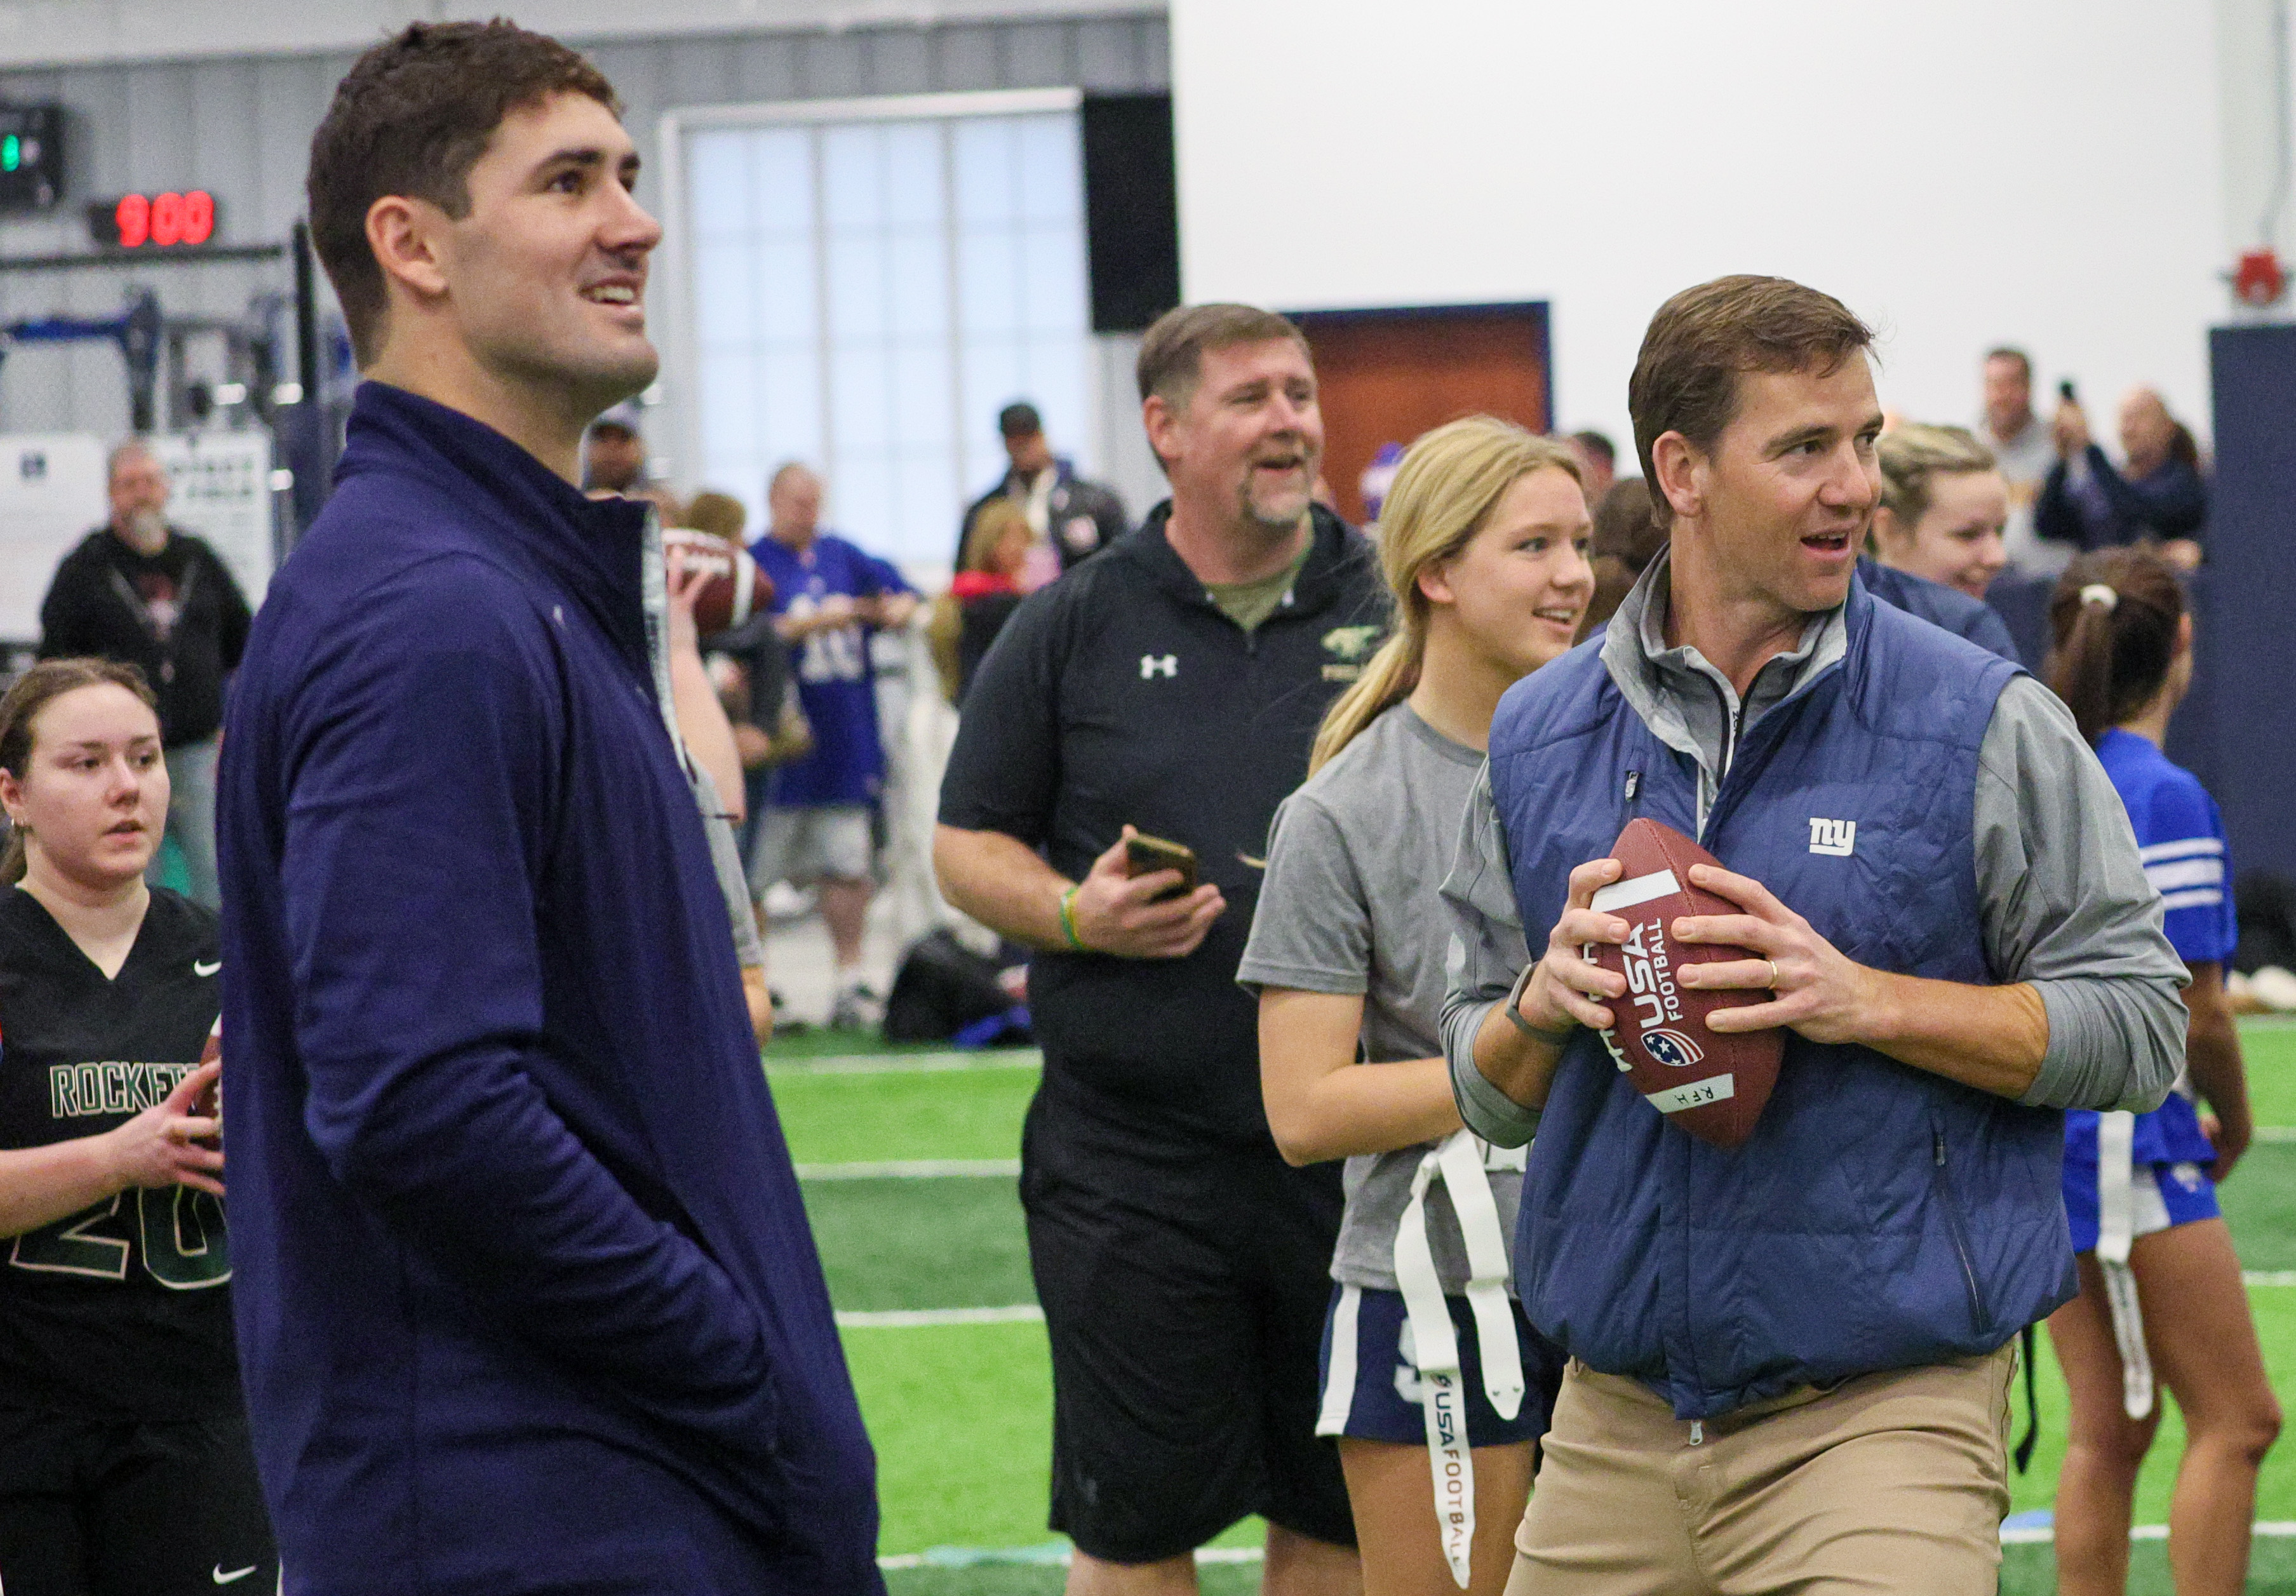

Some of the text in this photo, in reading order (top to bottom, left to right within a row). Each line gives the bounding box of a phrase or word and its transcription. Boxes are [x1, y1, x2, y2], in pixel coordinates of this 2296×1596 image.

[1621, 922, 1665, 1029] USA
[1648, 918, 1683, 1021] FOOTBALL
[50, 1061, 201, 1118] ROCKET
[1434, 1391, 1454, 1446] USA
